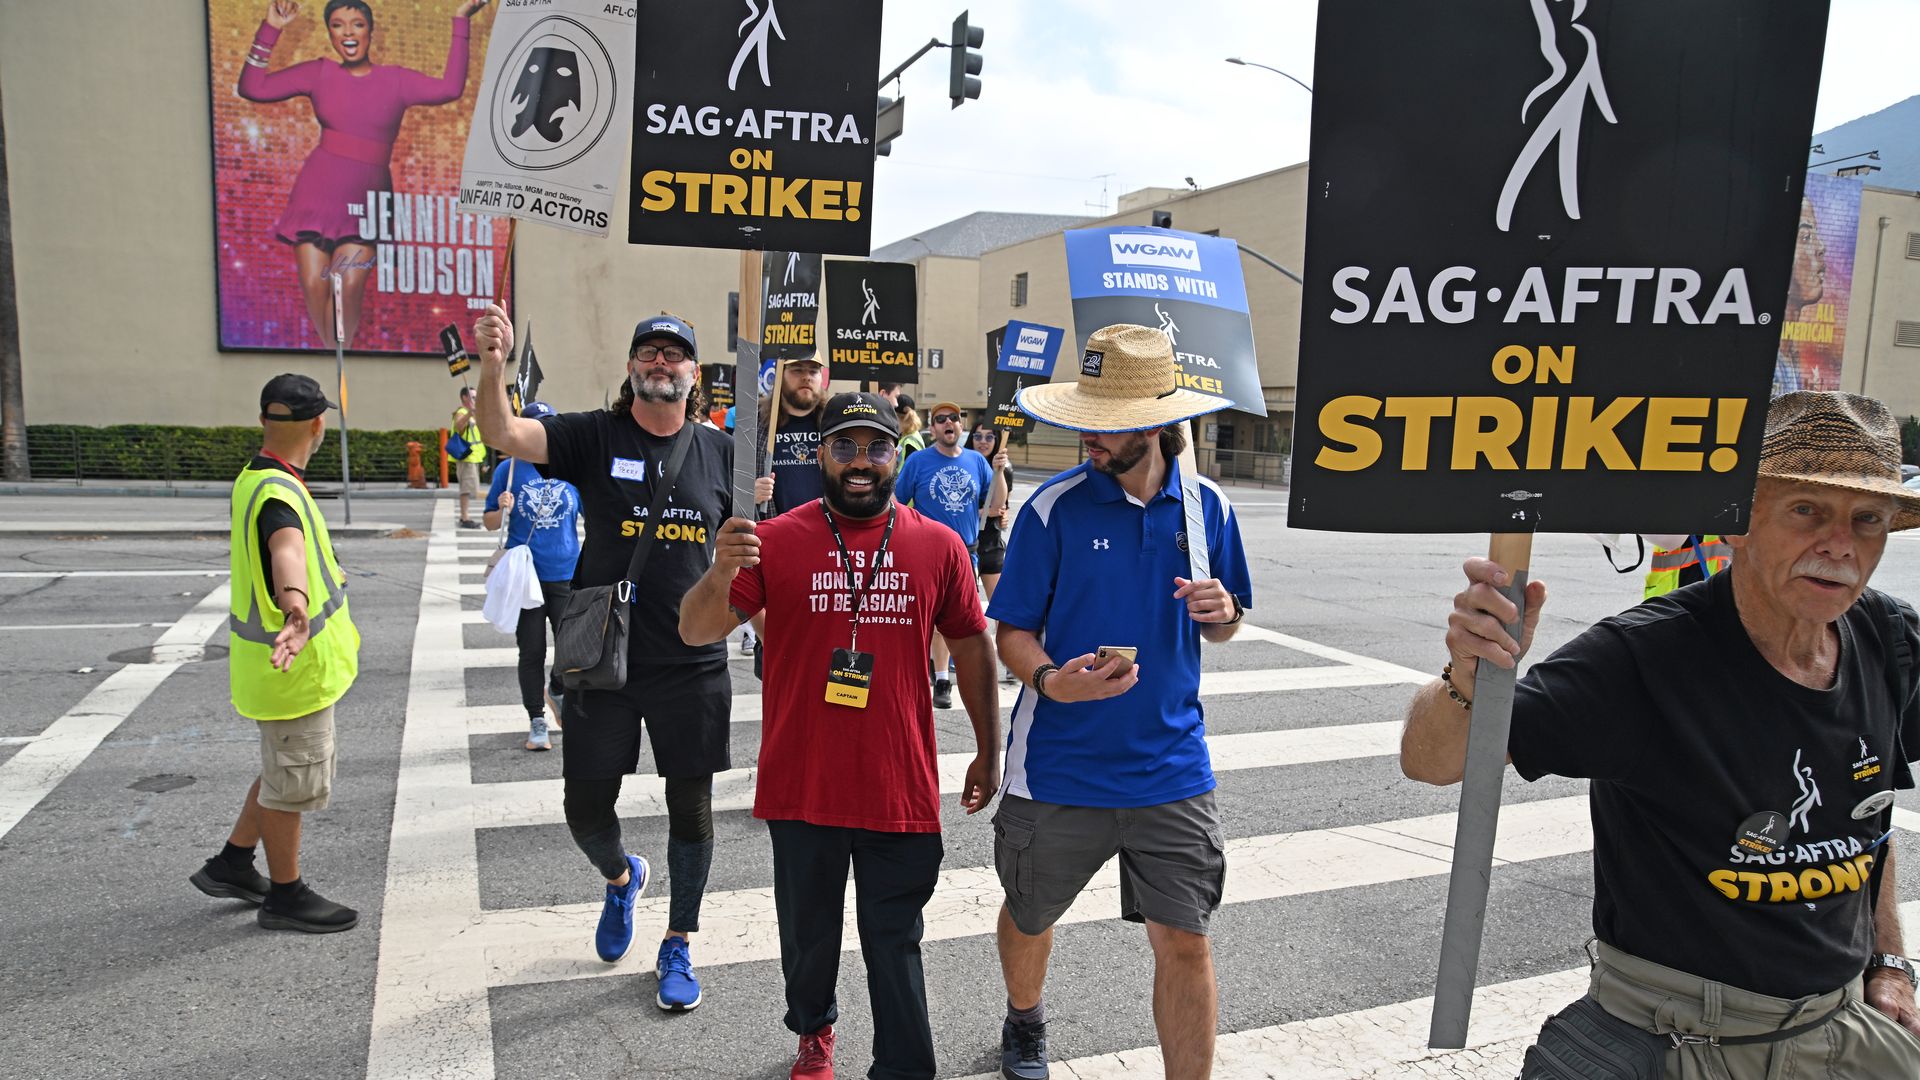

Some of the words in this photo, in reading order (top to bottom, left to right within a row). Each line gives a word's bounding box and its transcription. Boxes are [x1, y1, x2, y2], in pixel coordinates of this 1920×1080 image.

[603, 4, 637, 18] AFL-CI
[729, 148, 773, 171] ON
[525, 185, 543, 195] MGM
[544, 190, 557, 198] and
[559, 192, 582, 204] Disney
[640, 170, 863, 222] STRIKE!
[347, 203, 364, 216] THE
[460, 188, 502, 207] UNFAIR
[506, 193, 525, 209] TO
[529, 198, 608, 228] ACTORS
[358, 190, 493, 246] JENNIFER
[1115, 243, 1194, 260] WGAW
[377, 244, 494, 297] HUDSON
[1102, 272, 1169, 291] STANDS
[1174, 275, 1218, 299] WITH
[780, 312, 793, 323] ON
[1817, 304, 1834, 322] ALL
[764, 324, 814, 345] STRIKE!
[1020, 335, 1045, 346] WGAW
[865, 342, 879, 350] EN
[832, 349, 914, 366] HUELGA!
[932, 353, 939, 368] 6
[1008, 354, 1029, 368] STANDS
[1030, 358, 1045, 371] WITH
[1491, 344, 1576, 385] ON
[1173, 364, 1183, 372] N
[1175, 373, 1223, 394] IKE!
[994, 416, 1024, 427] STRIKE!
[776, 432, 821, 443] PSWIC
[1313, 395, 1748, 473] STRIKE!
[869, 572, 909, 591] JUST
[809, 594, 828, 612] TO
[833, 593, 853, 612] BE
[844, 672, 869, 681] STRIKE!
[836, 692, 858, 700] CAPTAIN
[1853, 765, 1881, 781] STRIKE!
[1738, 838, 1772, 854] STRIKE!
